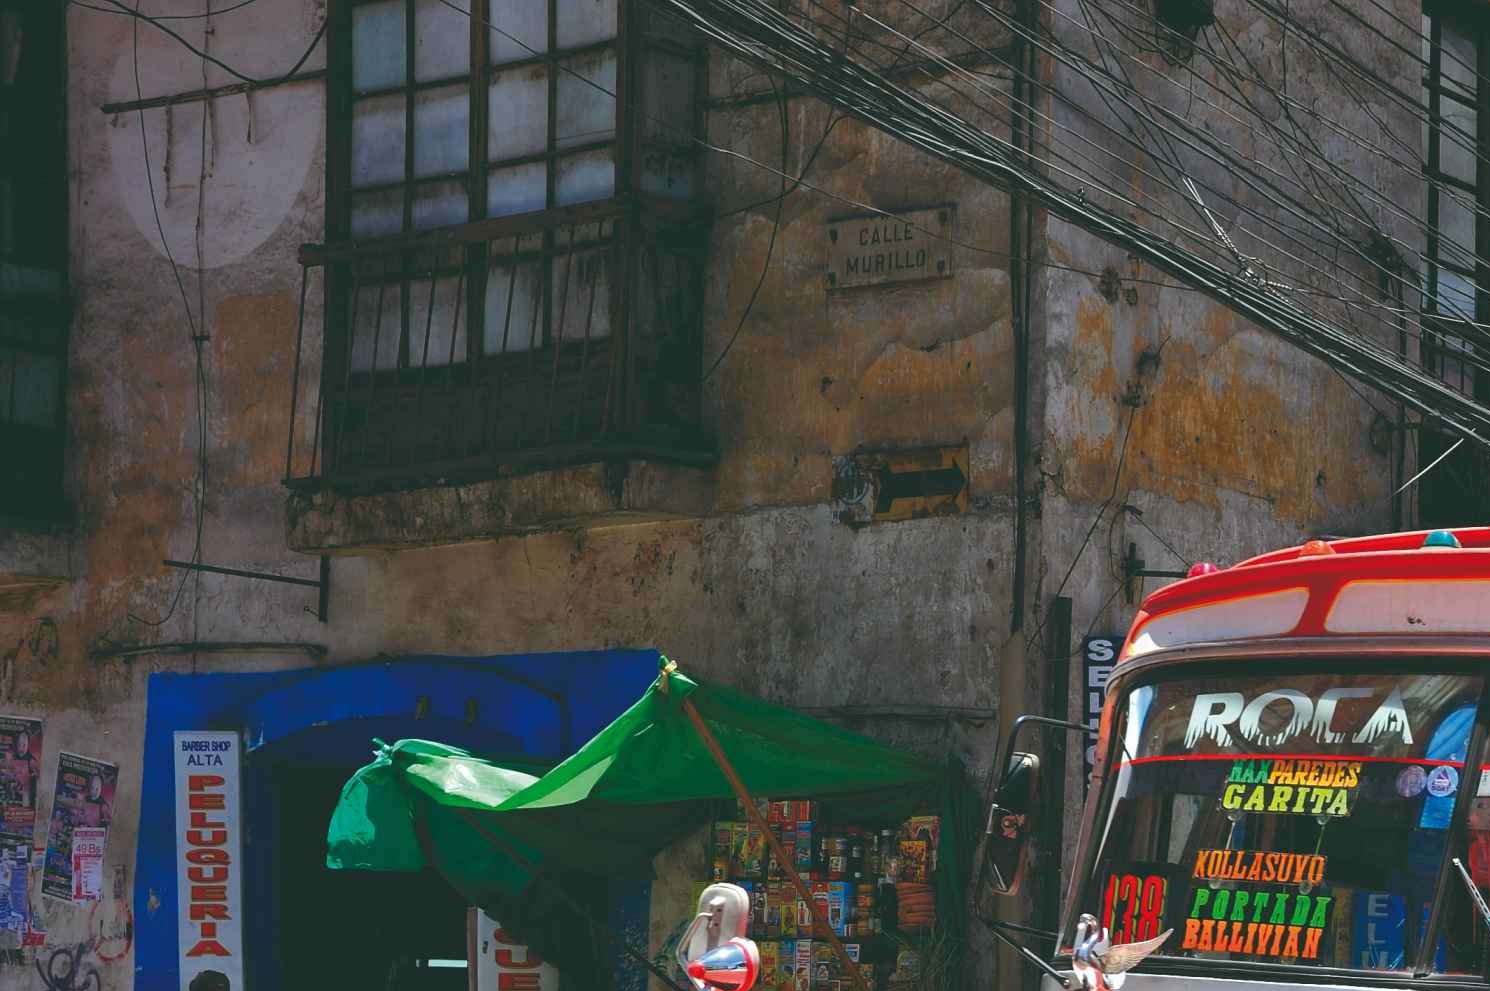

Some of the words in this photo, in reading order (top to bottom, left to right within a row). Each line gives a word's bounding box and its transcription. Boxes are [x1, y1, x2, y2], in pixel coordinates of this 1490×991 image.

[859, 223, 913, 246] CALLE
[846, 250, 926, 276] MURILLO
[1184, 686, 1413, 748] ROCA
[181, 741, 210, 751] BARBER
[212, 741, 231, 751] SHOP
[187, 754, 223, 766] ALTA
[1268, 760, 1361, 788] PAREDES
[1222, 784, 1349, 815] GARITA
[186, 774, 232, 957] PELUQUERIA
[1193, 850, 1326, 886] KOLLASUYO
[1103, 874, 1168, 946] 138
[1190, 888, 1332, 928] PORTADA
[1183, 918, 1323, 959] BALLIVIAN
